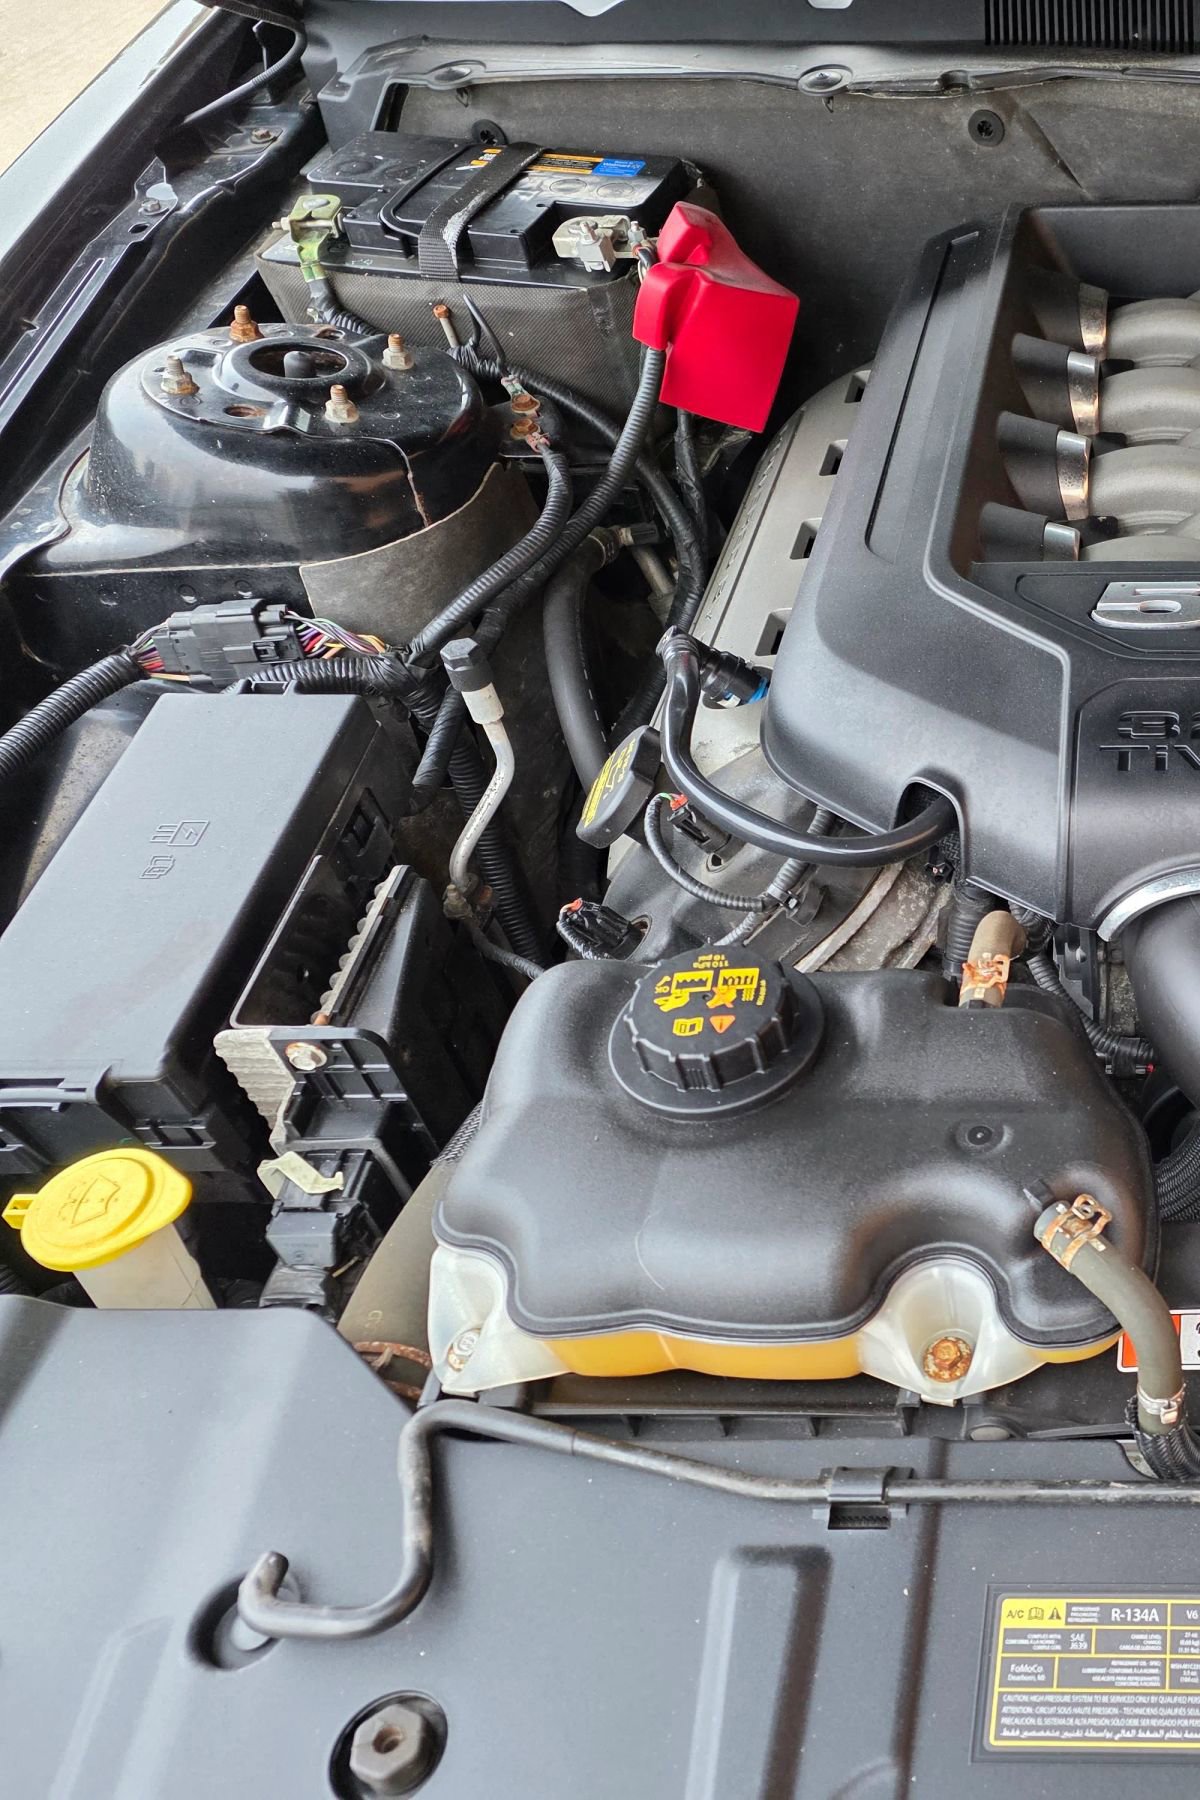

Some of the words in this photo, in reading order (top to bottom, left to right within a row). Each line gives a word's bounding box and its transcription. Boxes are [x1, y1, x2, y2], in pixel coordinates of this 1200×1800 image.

[1006, 1610, 1024, 1619] A/C
[1111, 1608, 1159, 1622] R-134A
[1186, 1609, 1199, 1620] V6
[1010, 1664, 1043, 1673] FoMoCo
